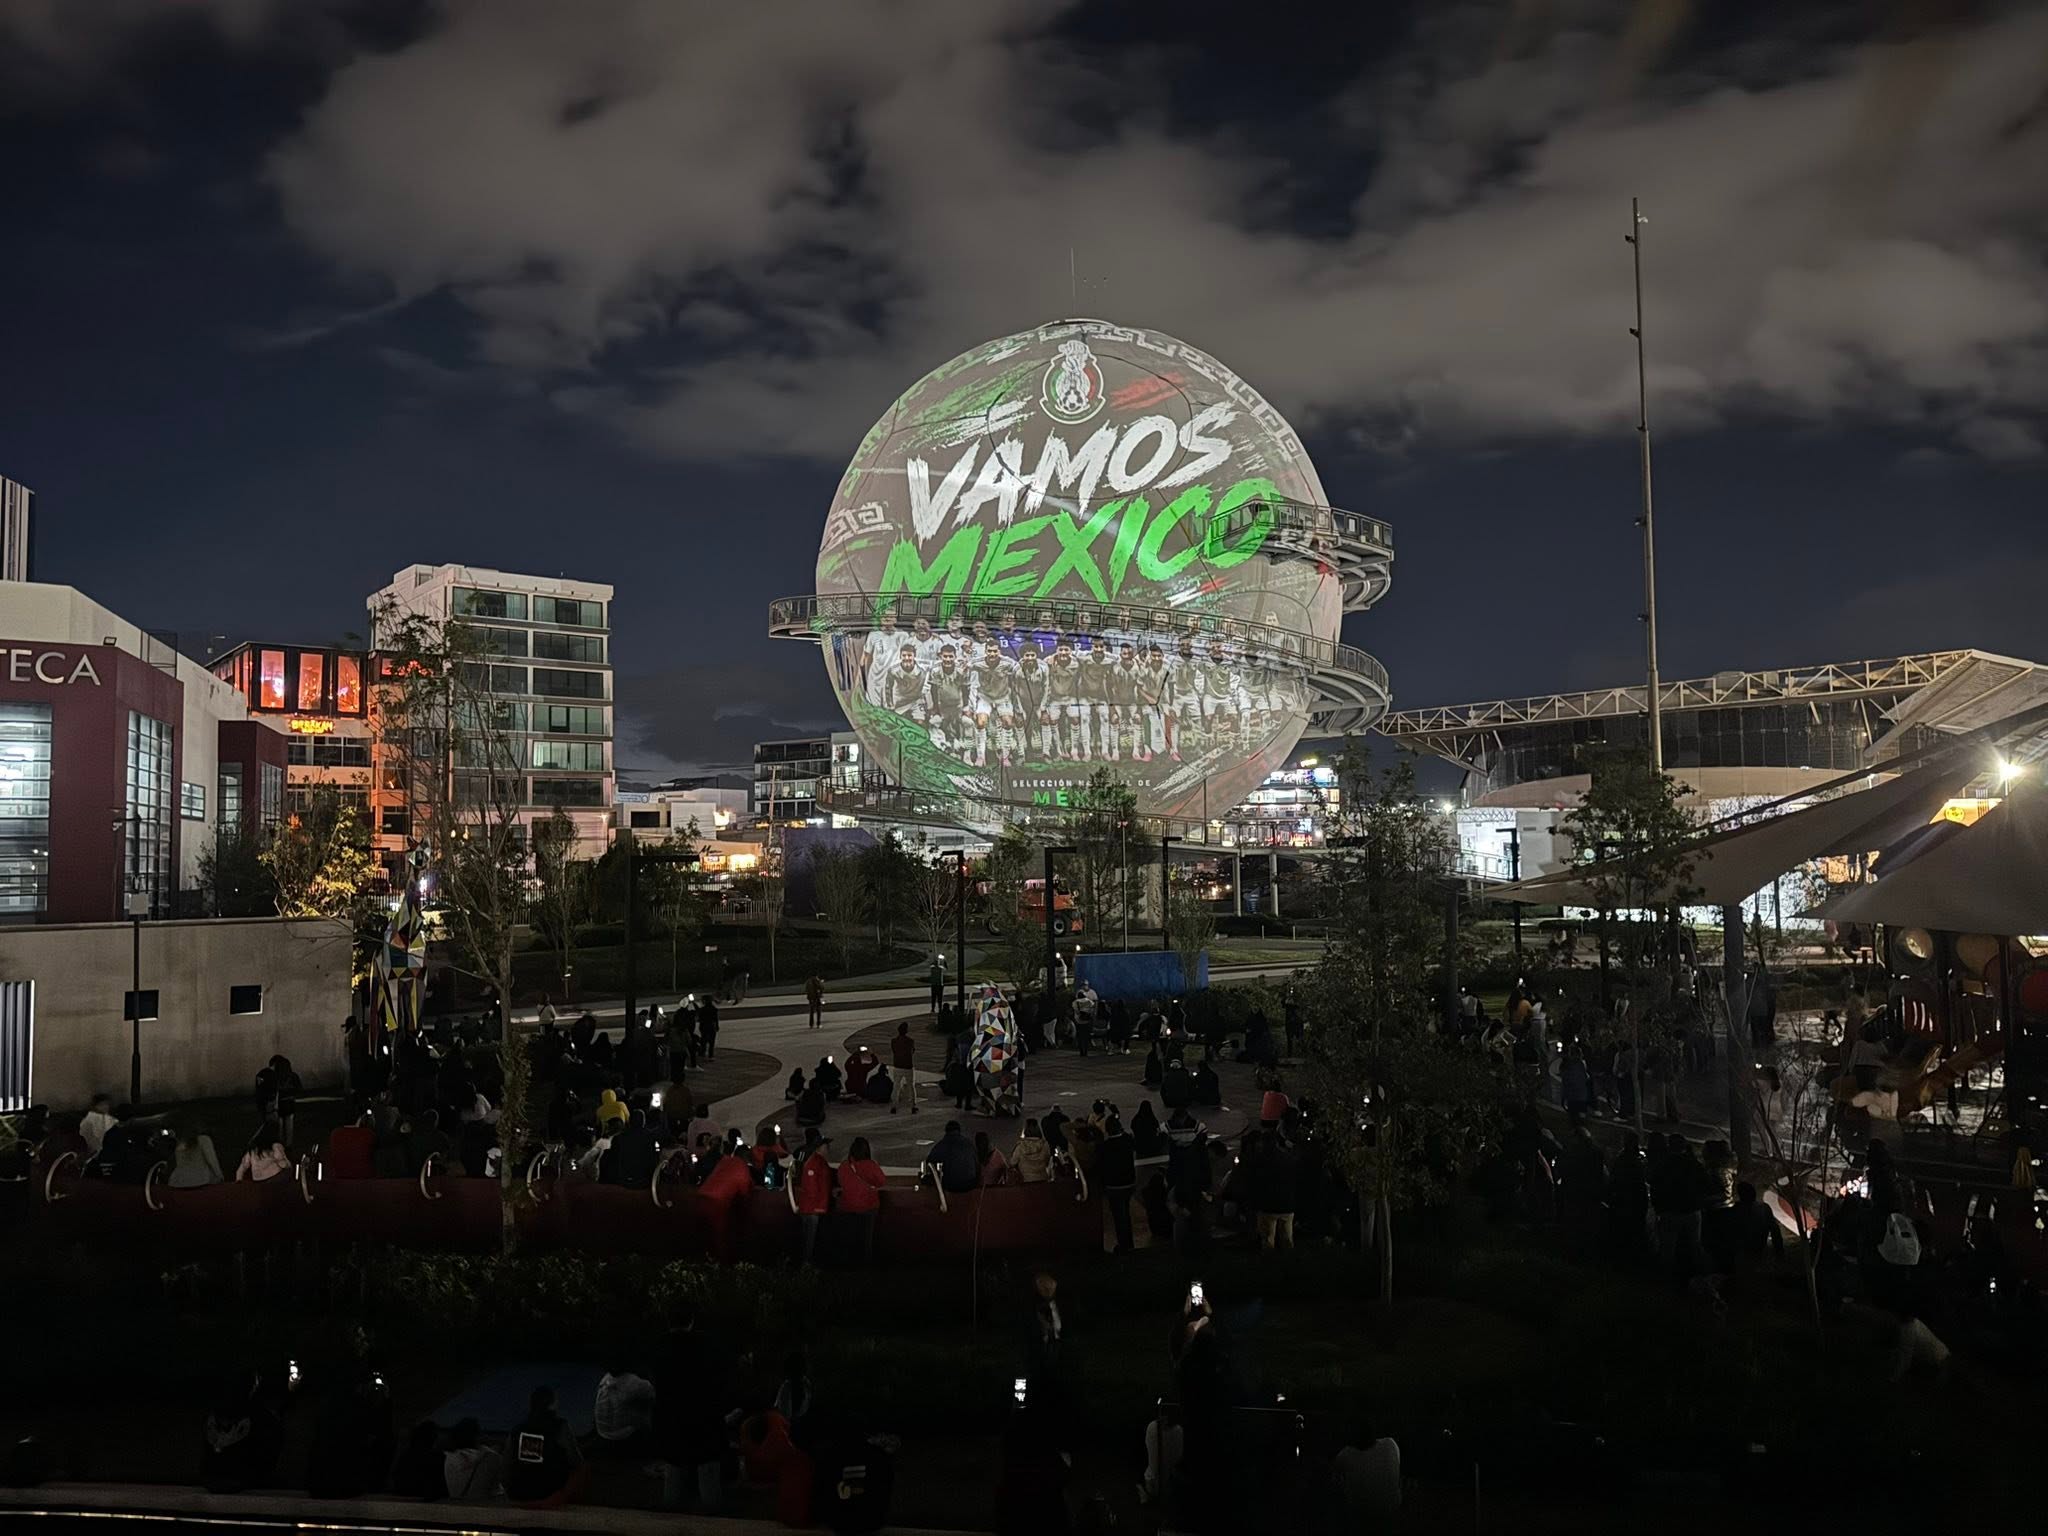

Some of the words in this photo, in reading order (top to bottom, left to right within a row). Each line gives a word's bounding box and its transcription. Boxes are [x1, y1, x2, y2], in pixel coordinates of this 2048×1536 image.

[907, 400, 1238, 550] VAMOS
[873, 477, 1282, 626] MEXICO
[999, 639, 1009, 648] 13
[1012, 778, 1073, 788] SELECCIÓN
[1137, 778, 1151, 788] DE
